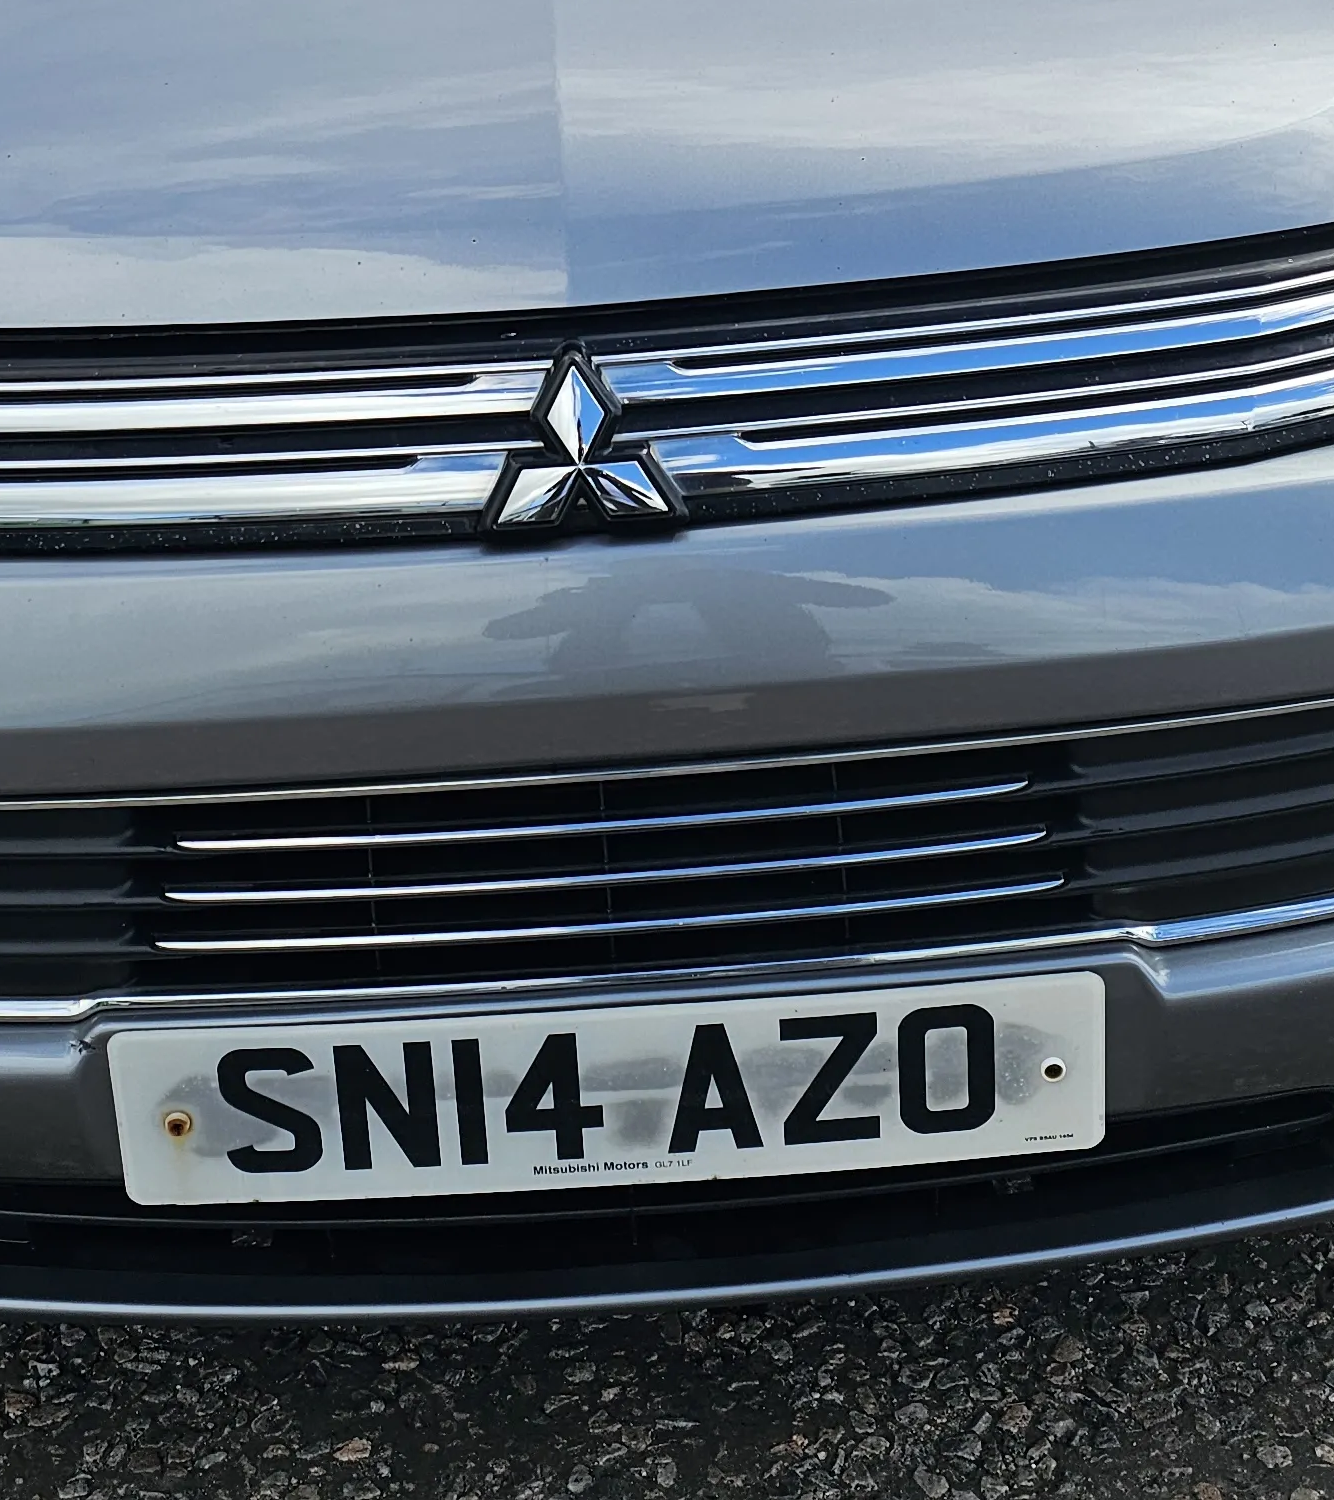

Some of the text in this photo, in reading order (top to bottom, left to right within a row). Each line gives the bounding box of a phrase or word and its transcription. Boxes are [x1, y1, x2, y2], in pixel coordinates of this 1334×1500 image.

[216, 1003, 996, 1175] SN14 AZO
[533, 1162, 600, 1176] Mitsubishi
[603, 1160, 649, 1171] Motors
